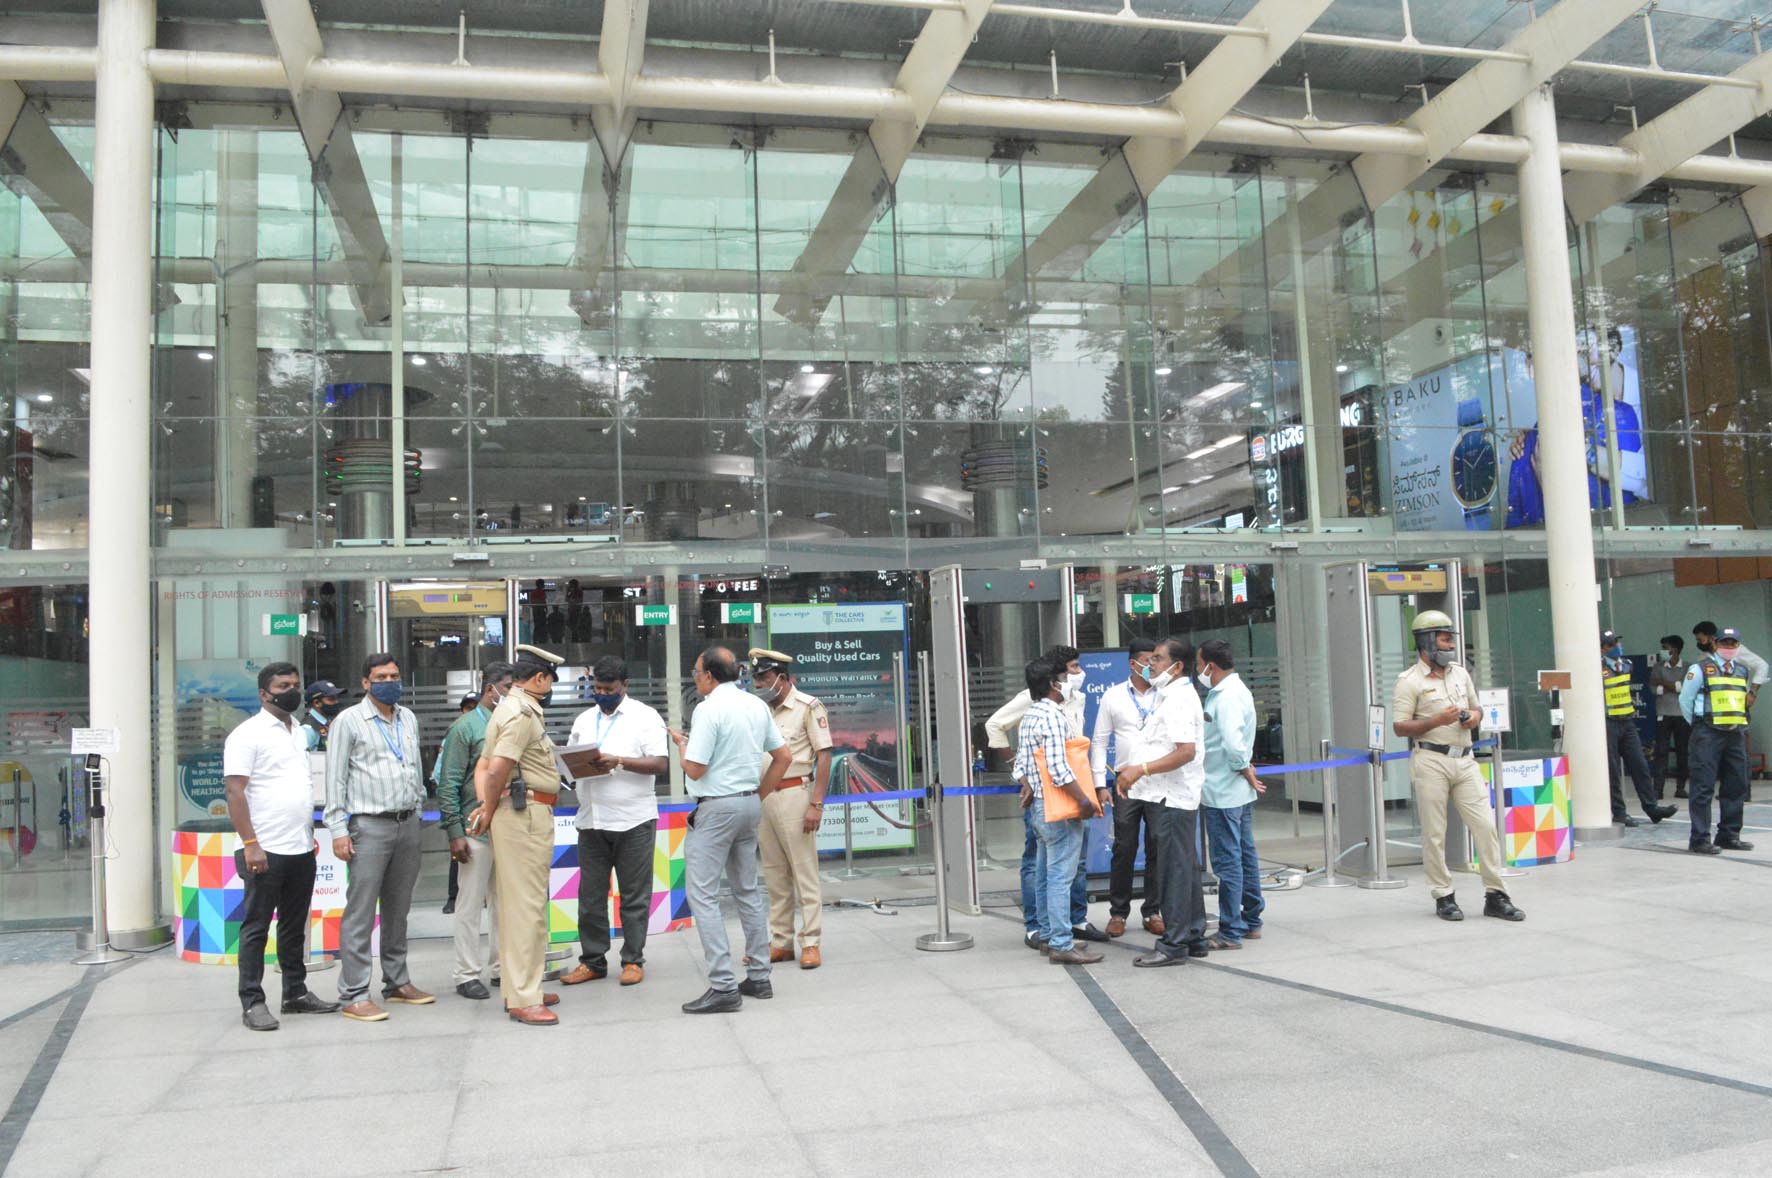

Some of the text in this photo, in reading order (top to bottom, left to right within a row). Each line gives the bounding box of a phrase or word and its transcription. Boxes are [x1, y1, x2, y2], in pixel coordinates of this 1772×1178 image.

[164, 591, 196, 600] RIGHTS
[198, 591, 208, 599] OF
[212, 590, 262, 599] ADMISSION
[643, 611, 669, 619] ENTRY
[815, 640, 862, 651] Buy & Sell
[796, 652, 881, 664] Quality Used Cars
[1086, 682, 1105, 694] Get
